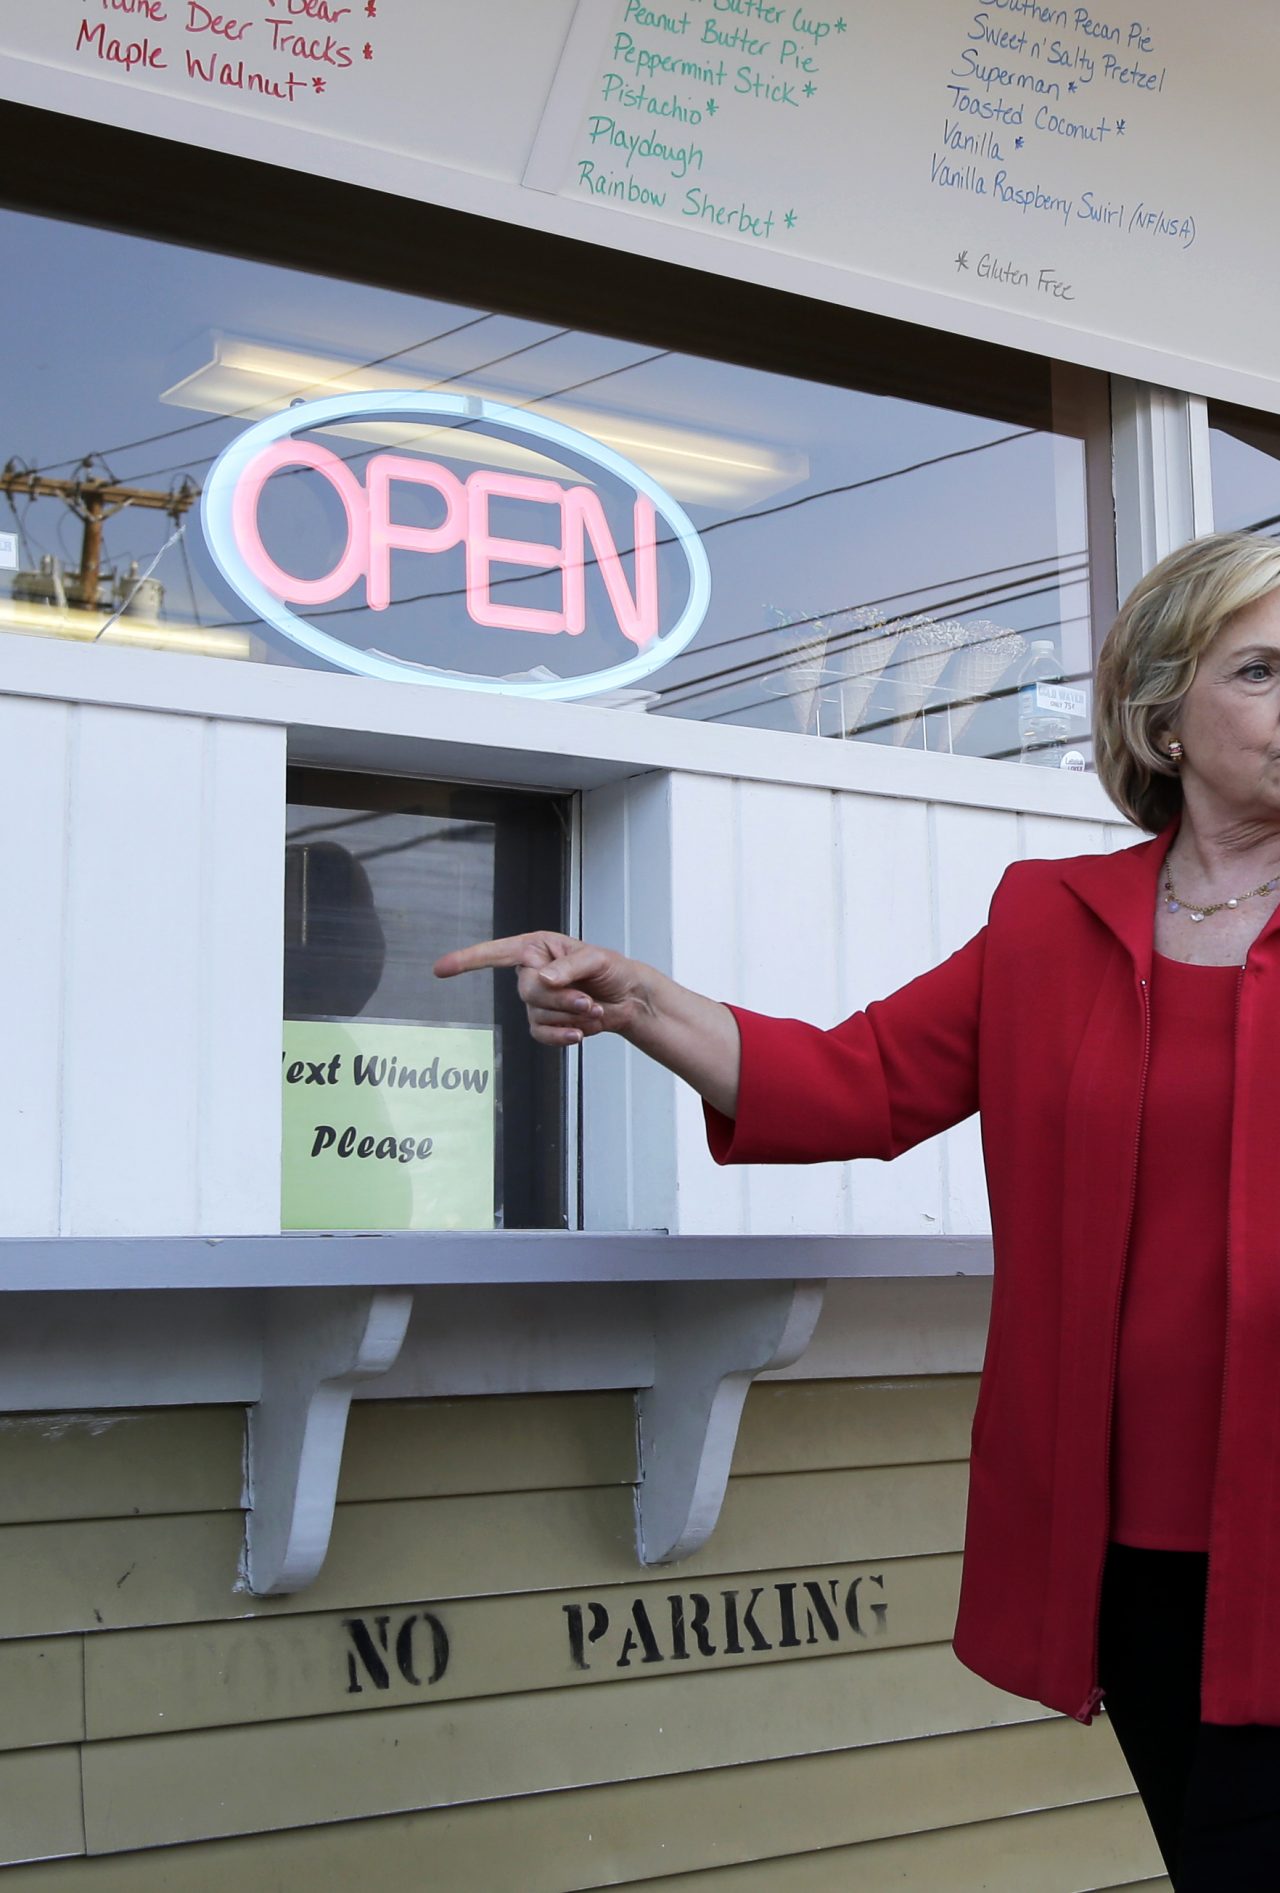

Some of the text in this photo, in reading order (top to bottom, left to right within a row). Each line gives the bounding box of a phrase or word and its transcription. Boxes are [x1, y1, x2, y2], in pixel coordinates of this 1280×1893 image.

[82, 0, 352, 67] aine Deer Tracks
[624, 0, 819, 73] Peanut Butter Pie
[793, 8, 830, 45] Cup
[967, 13, 1027, 51] Sweet
[1047, 41, 1095, 83] Salty
[1103, 54, 1165, 92] Pretzel
[1074, 8, 1120, 45] Pecan
[1128, 23, 1154, 52] Pie
[76, 19, 306, 101] Maple Walnut
[614, 32, 799, 107] Peppermint Stick
[951, 48, 1059, 100] Superman
[602, 73, 701, 125] Pistachio
[946, 85, 1111, 142] Toasted Coconut
[589, 116, 703, 178] Playdough
[944, 119, 1004, 161] Vanilla
[578, 161, 775, 238] Rainbow Sherbet
[931, 152, 986, 195] Vanilla
[993, 170, 1072, 226] Raspberry
[1077, 192, 1124, 228] Swirl
[976, 254, 1075, 300] Gluten Free
[232, 440, 659, 650] OPEN
[282, 1051, 489, 1094] ext Window
[311, 1125, 433, 1163] Please
[342, 1575, 888, 1692] NO PARKING
